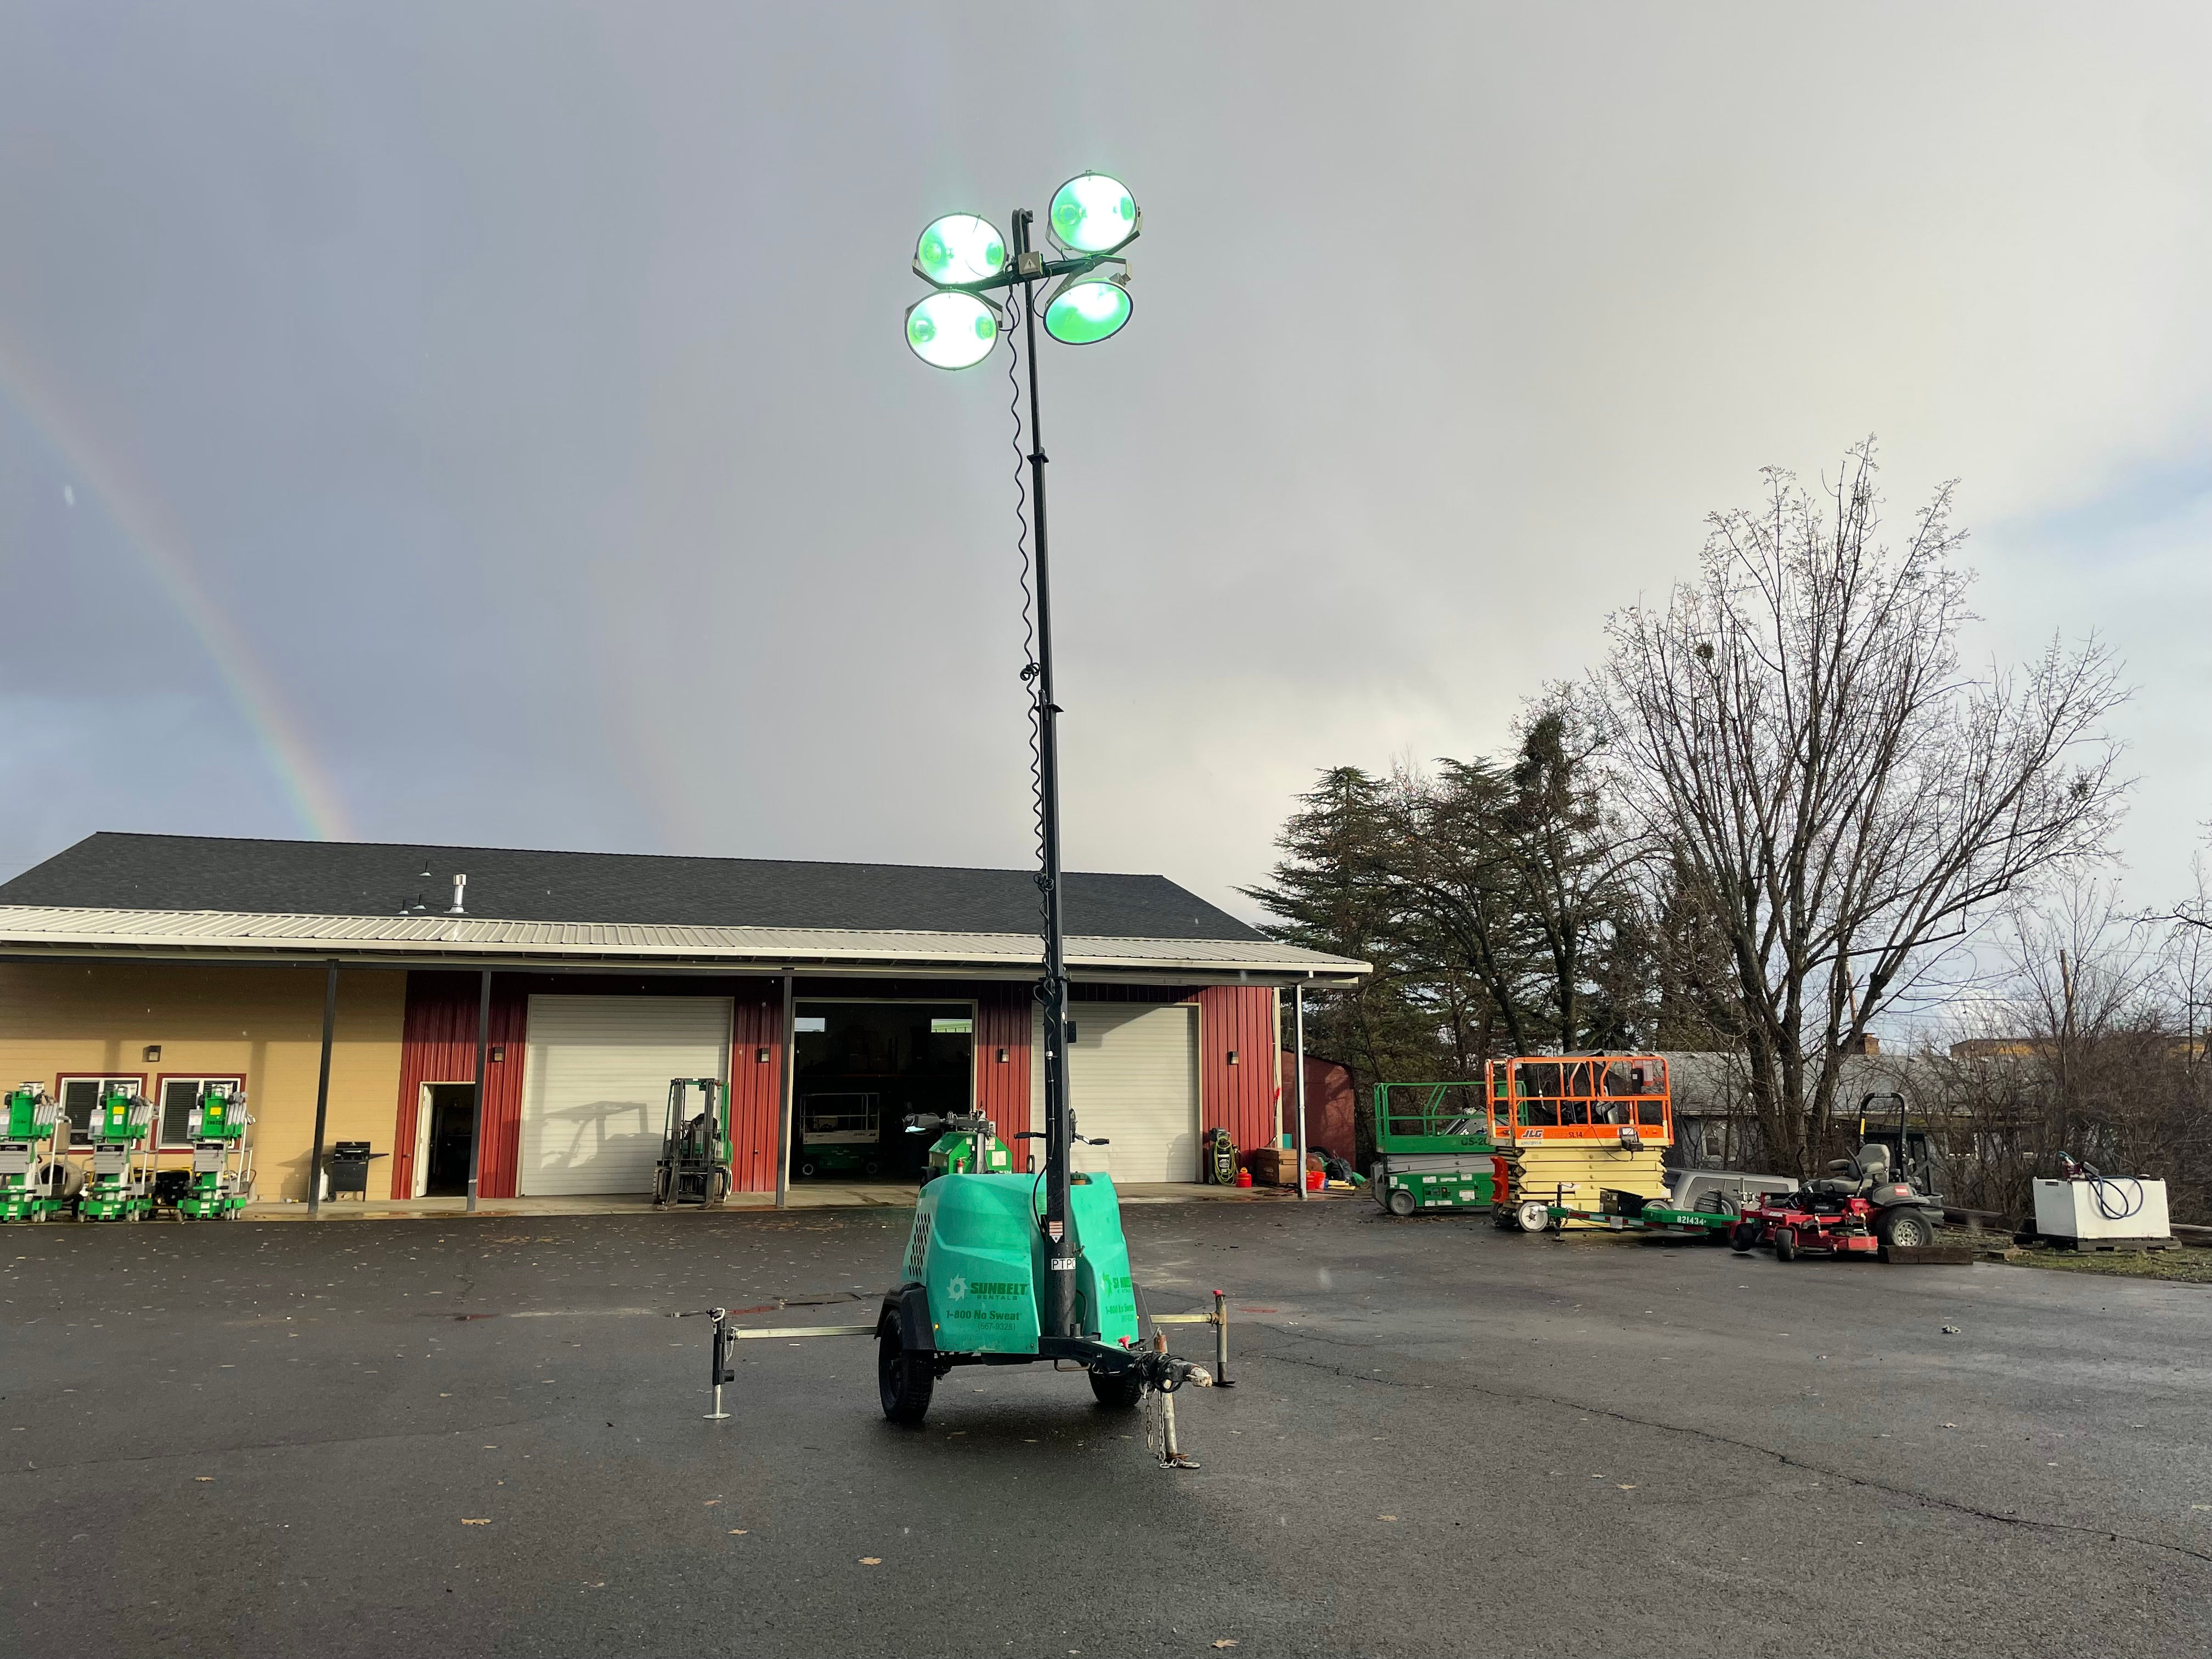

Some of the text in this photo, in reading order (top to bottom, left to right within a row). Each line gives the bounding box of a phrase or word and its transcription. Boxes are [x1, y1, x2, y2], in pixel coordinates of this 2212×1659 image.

[1522, 1130, 1544, 1138] JLG
[970, 1282, 1028, 1295] SUNBELT
[946, 1310, 1019, 1321] 1-800 No Sweat
[978, 1322, 1015, 1331] (667-9328)
